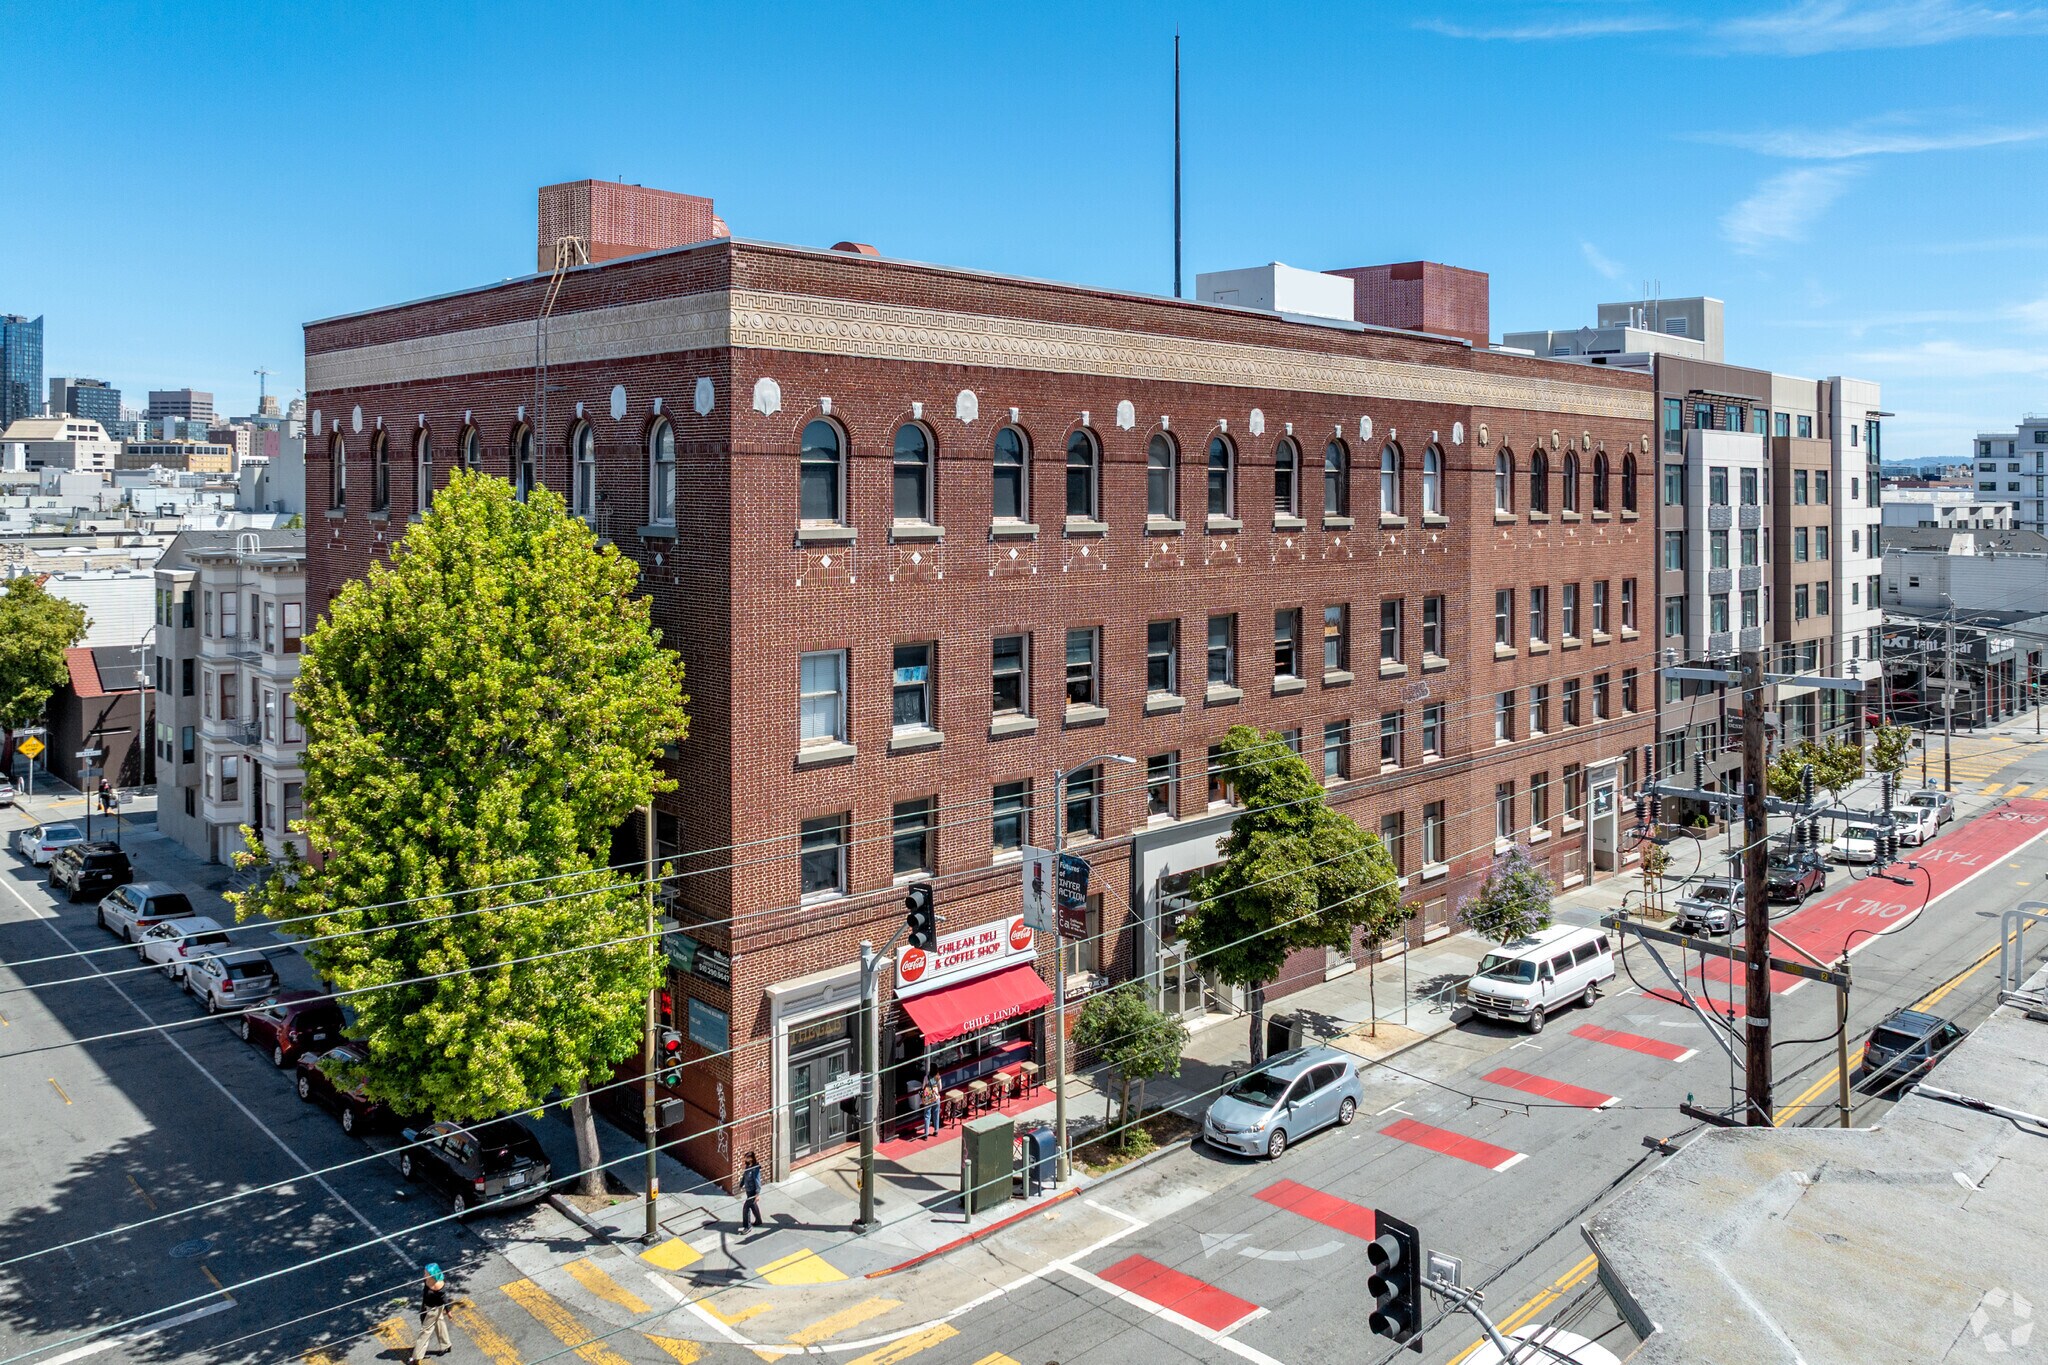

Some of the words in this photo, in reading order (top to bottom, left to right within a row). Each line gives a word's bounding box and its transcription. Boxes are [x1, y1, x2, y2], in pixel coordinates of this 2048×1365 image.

[1913, 639, 1938, 652] rent
[1918, 849, 1983, 866] TAXI
[1822, 898, 1908, 919] ONLY
[936, 935, 976, 956] CHILEAN
[979, 930, 998, 945] DELI
[934, 957, 942, 970] &
[943, 948, 976, 967] COFFEE
[977, 942, 1001, 958] SHOP
[963, 1012, 991, 1031] CHILE
[993, 1004, 1020, 1021] LINDO
